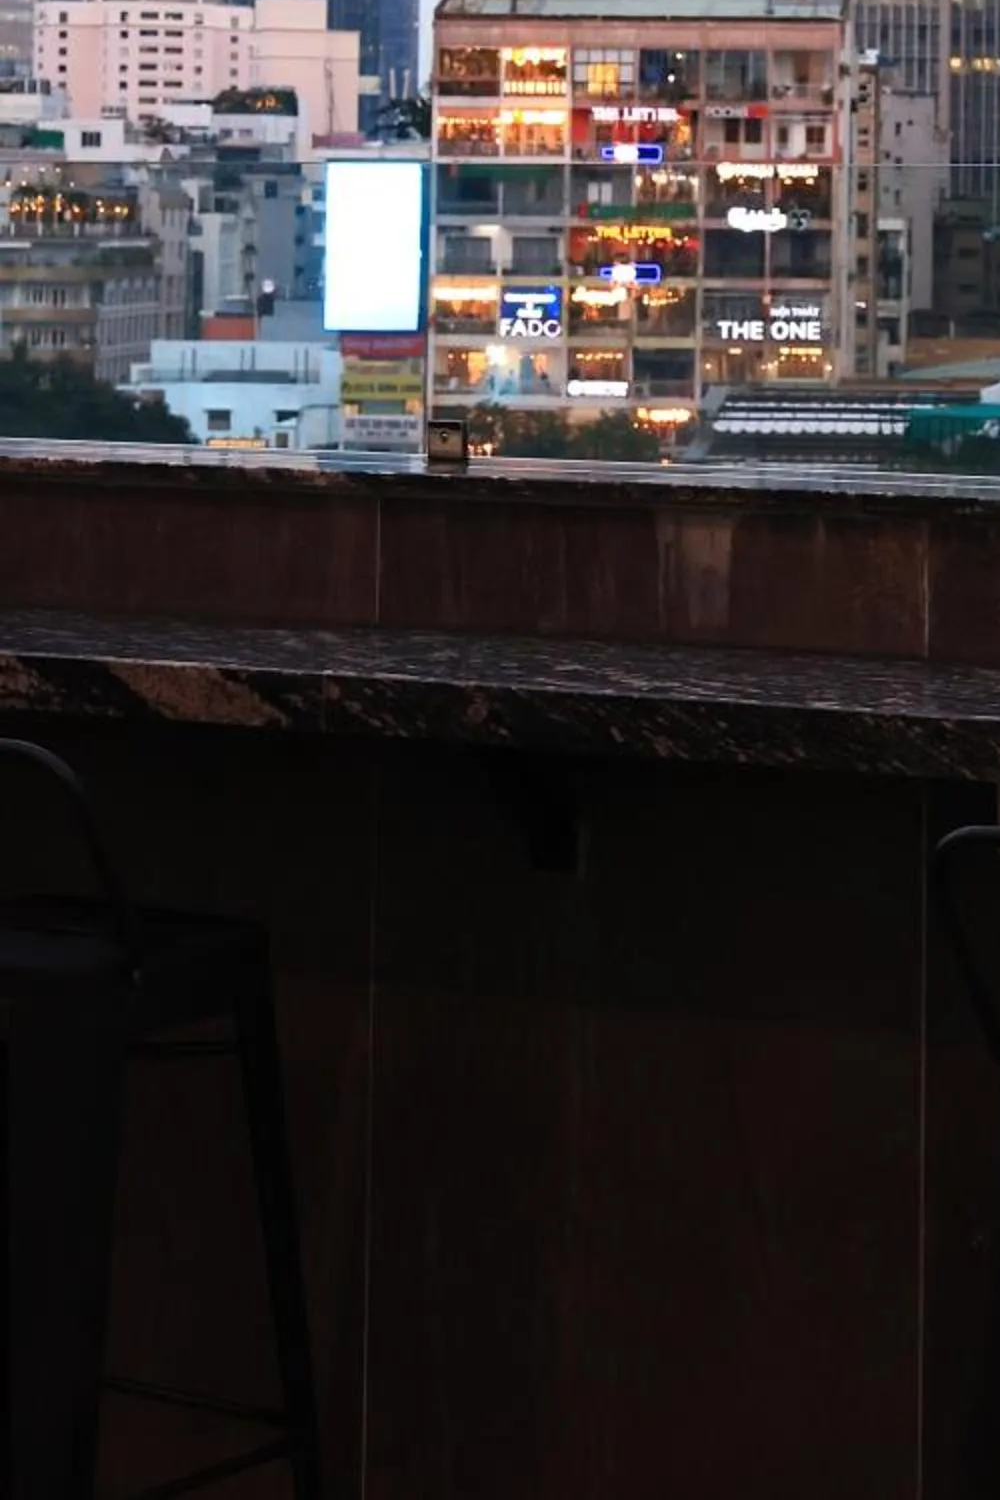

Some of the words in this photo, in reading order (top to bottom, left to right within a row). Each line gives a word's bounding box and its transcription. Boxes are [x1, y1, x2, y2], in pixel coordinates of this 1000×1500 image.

[499, 319, 562, 338] FADO
[717, 320, 765, 341] THE
[770, 320, 821, 341] ONE
